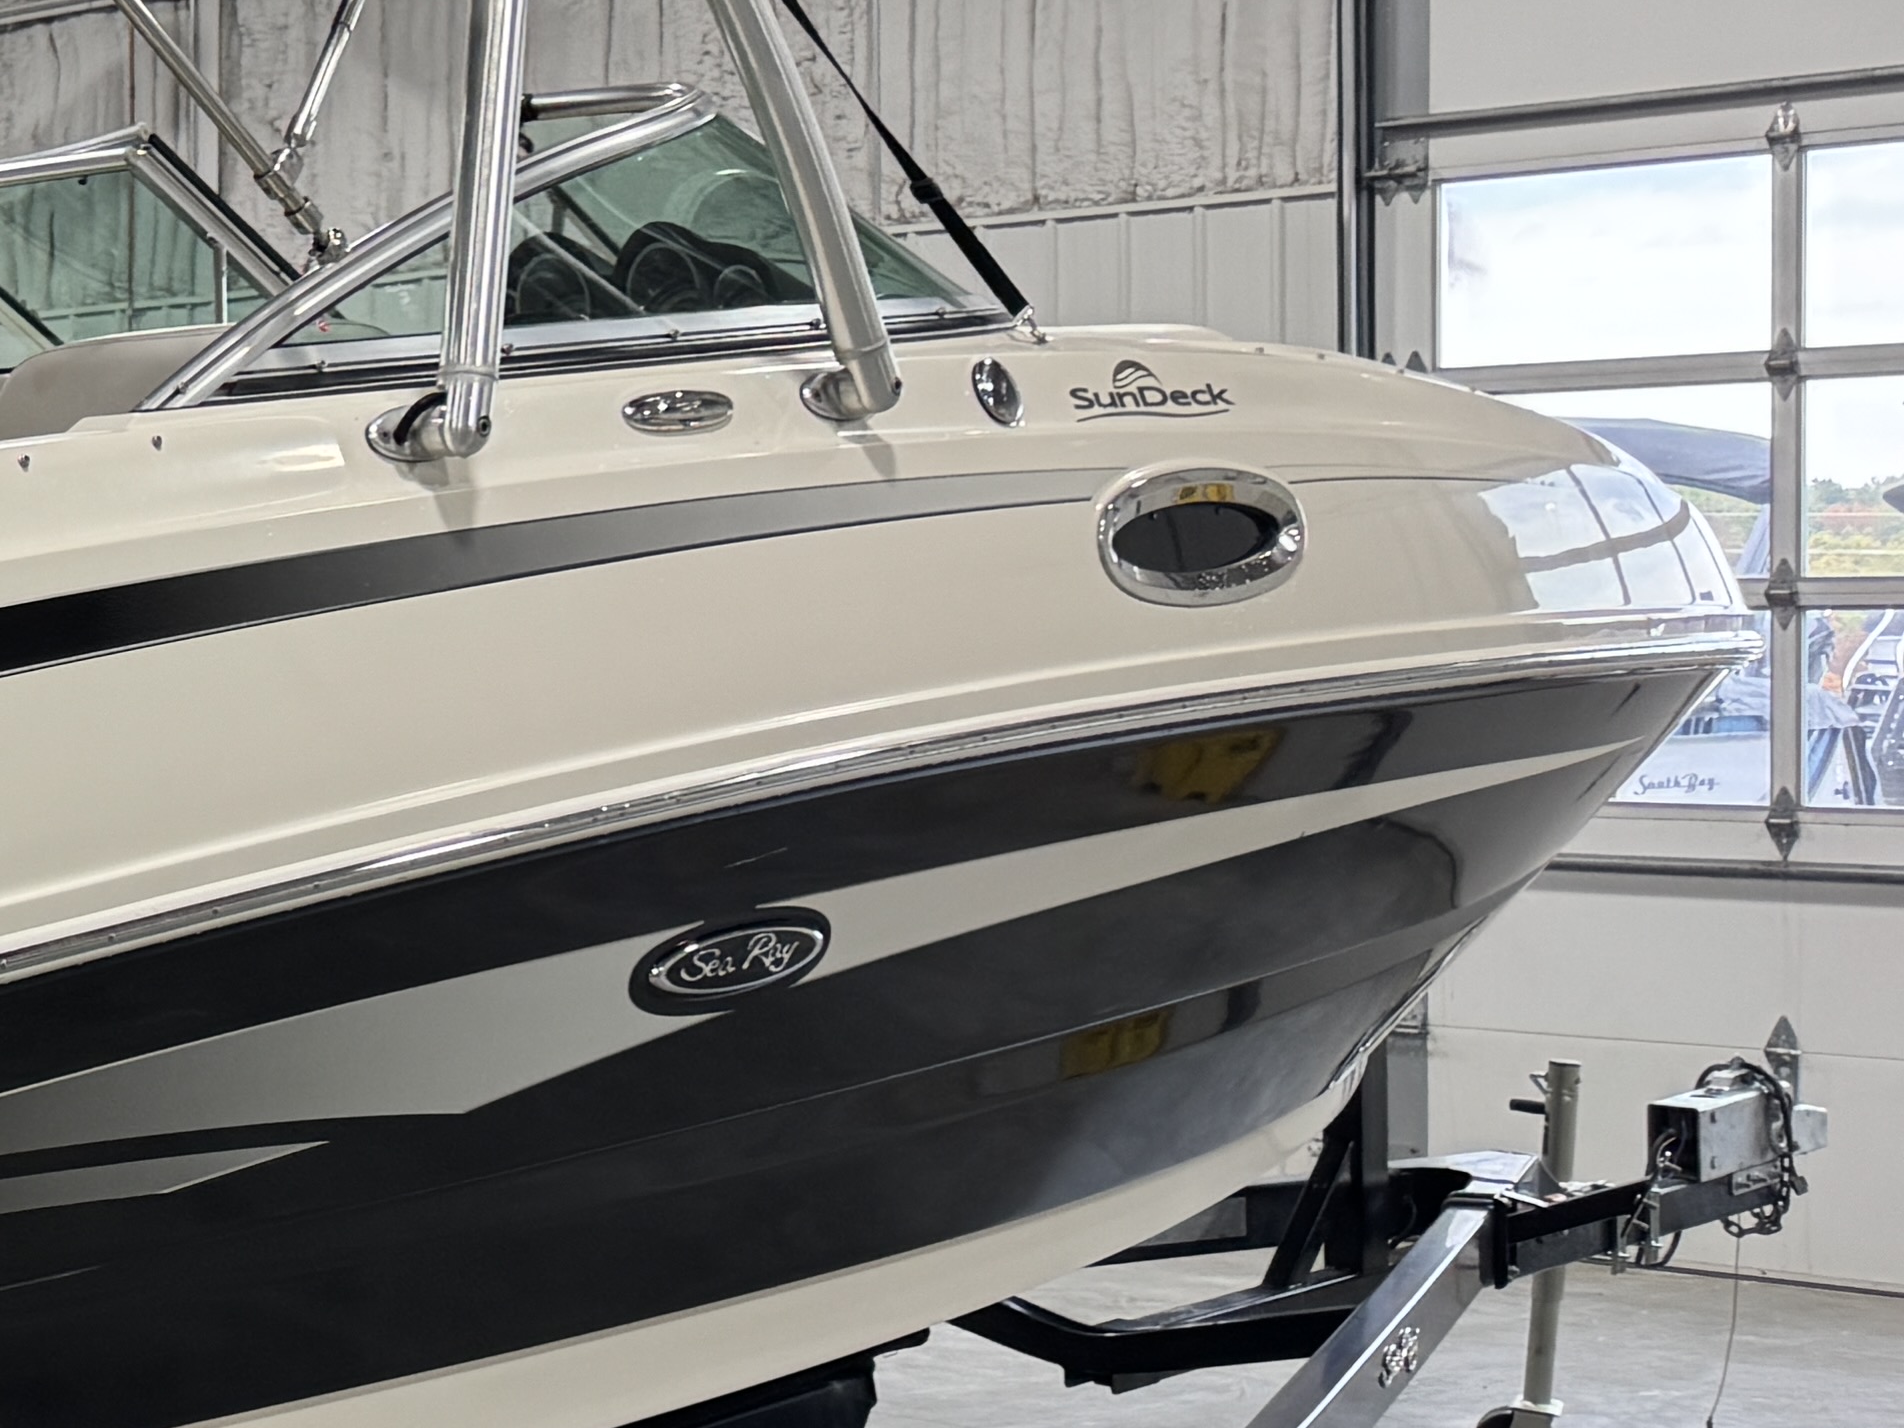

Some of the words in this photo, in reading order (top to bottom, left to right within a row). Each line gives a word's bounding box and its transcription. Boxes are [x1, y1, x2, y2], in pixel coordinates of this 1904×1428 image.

[1069, 382, 1236, 410] SunDeck
[680, 947, 736, 982] Sea
[741, 932, 800, 972] Ray
